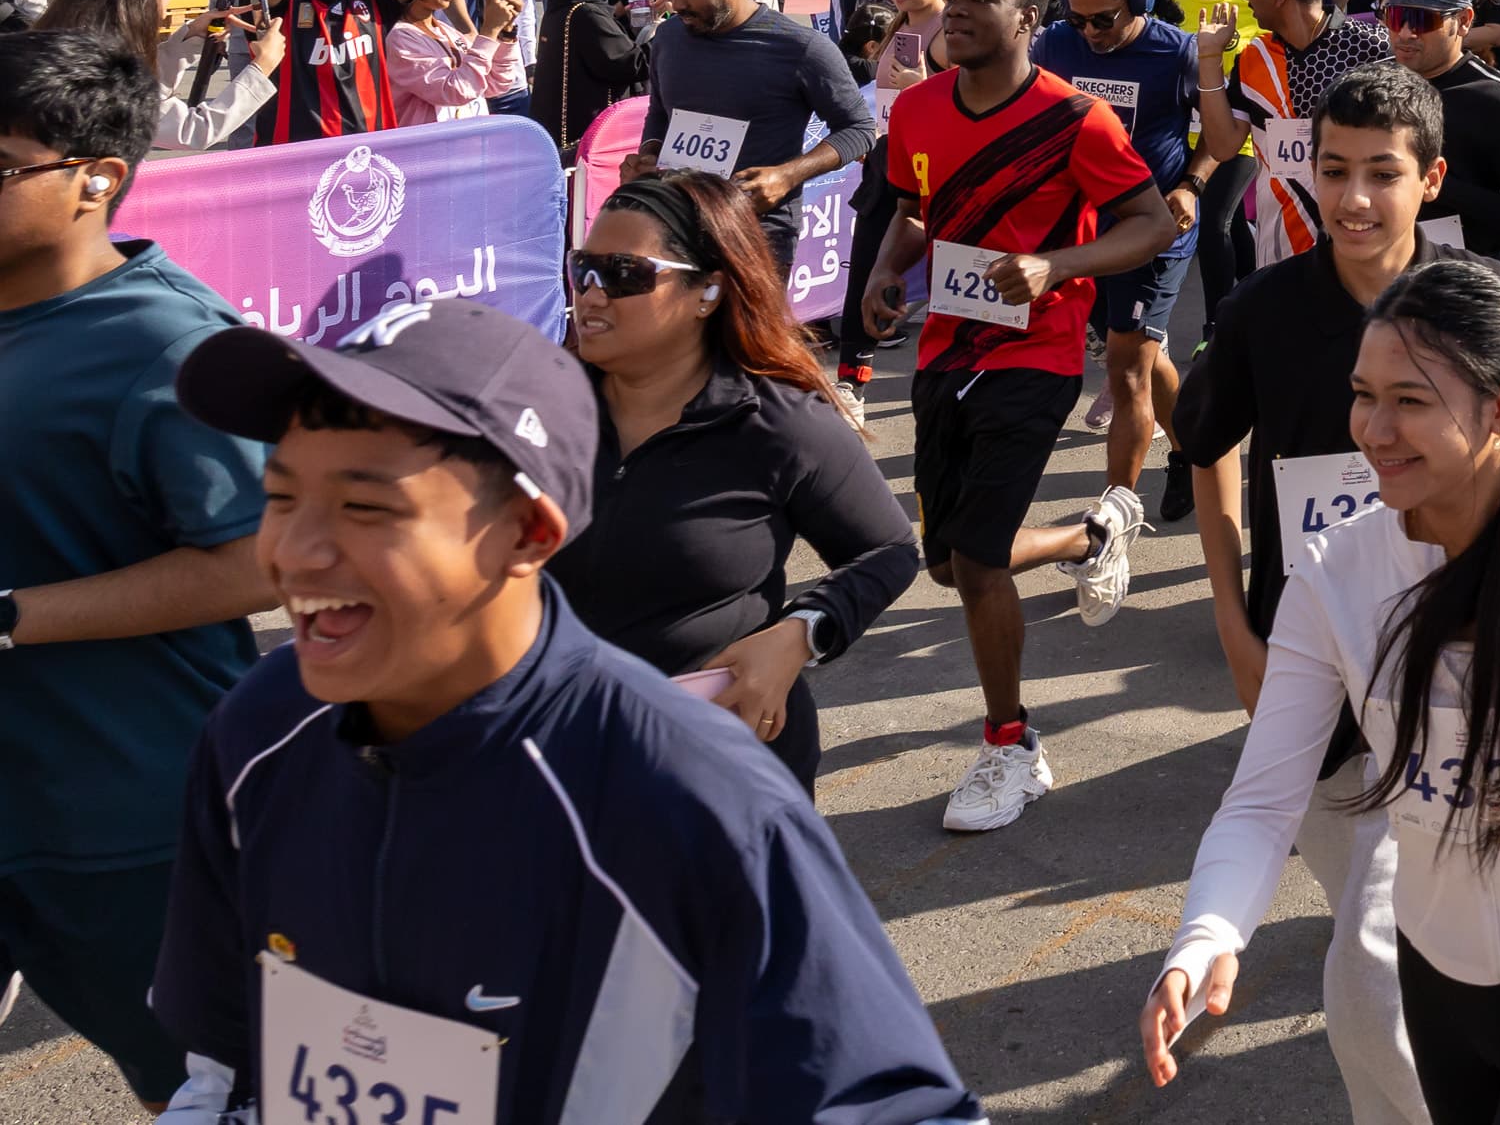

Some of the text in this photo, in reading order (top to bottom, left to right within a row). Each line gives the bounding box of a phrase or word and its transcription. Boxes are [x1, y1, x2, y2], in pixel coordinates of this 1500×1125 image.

[309, 32, 373, 66] bwin
[1076, 81, 1134, 95] SKECHERS
[671, 132, 731, 162] 4063
[1277, 140, 1313, 162] 40
[912, 152, 930, 196] 9
[799, 194, 841, 240] الات
[944, 267, 1017, 306] 428
[240, 271, 361, 346] الرياض
[1302, 491, 1381, 533] 43
